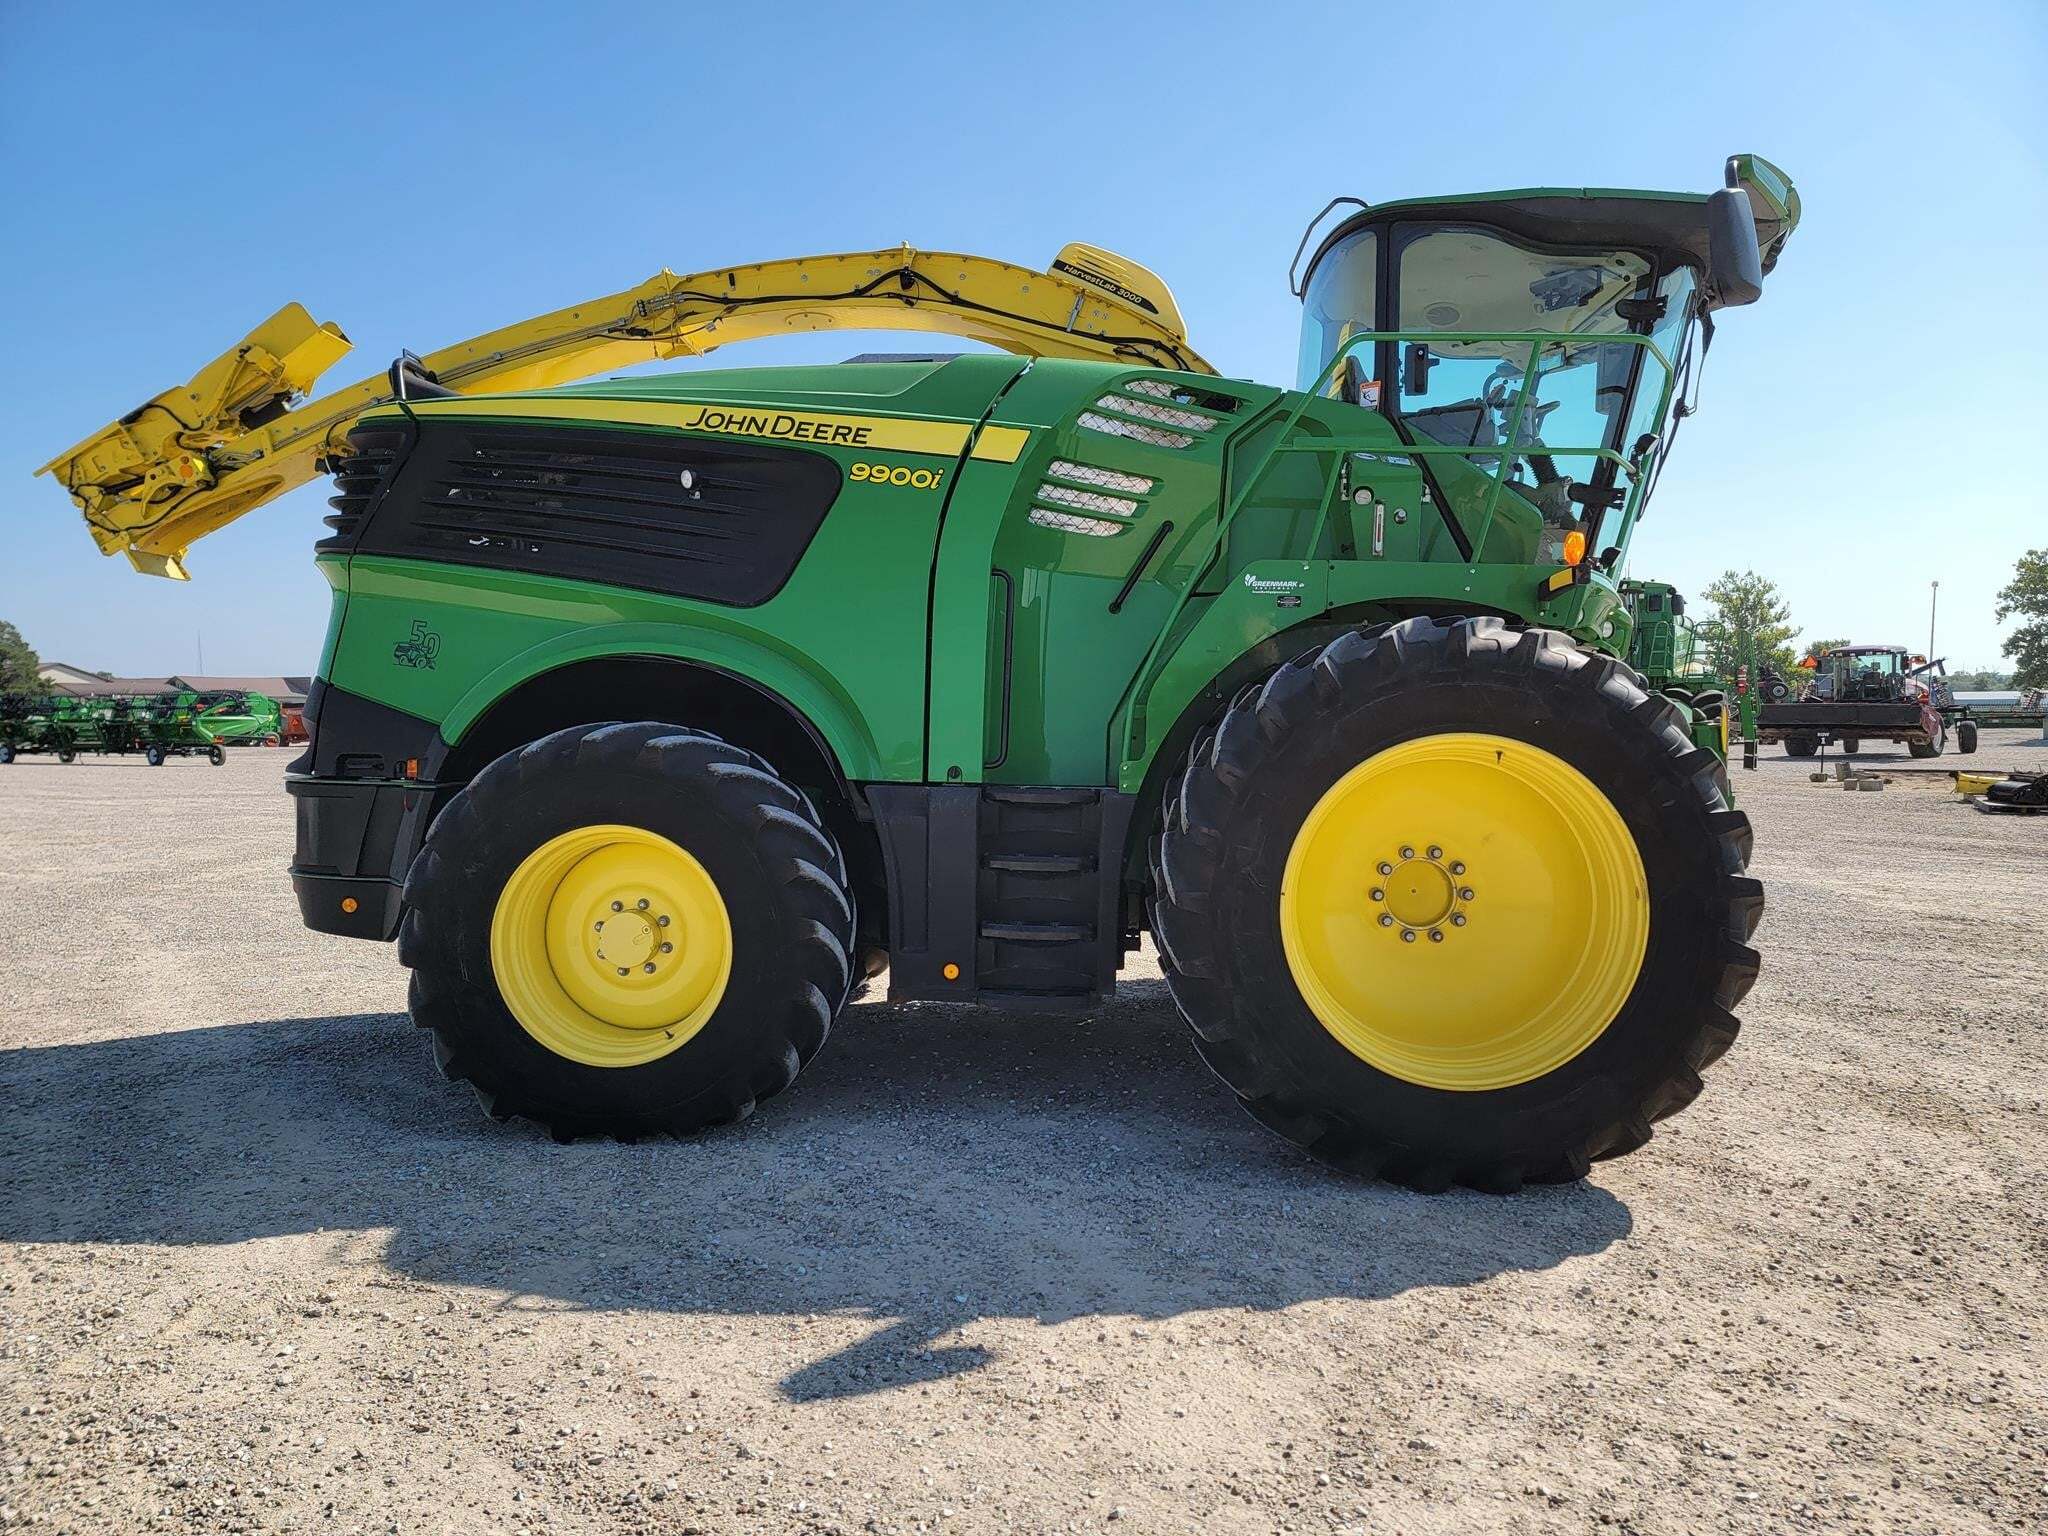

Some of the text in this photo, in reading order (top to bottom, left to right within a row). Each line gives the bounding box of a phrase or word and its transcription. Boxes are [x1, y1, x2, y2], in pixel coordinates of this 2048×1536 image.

[1063, 264, 1142, 304] HarvestLab 3000
[686, 407, 872, 444] JOHN DEERE
[849, 462, 944, 490] 9900i
[410, 619, 440, 659] 50
